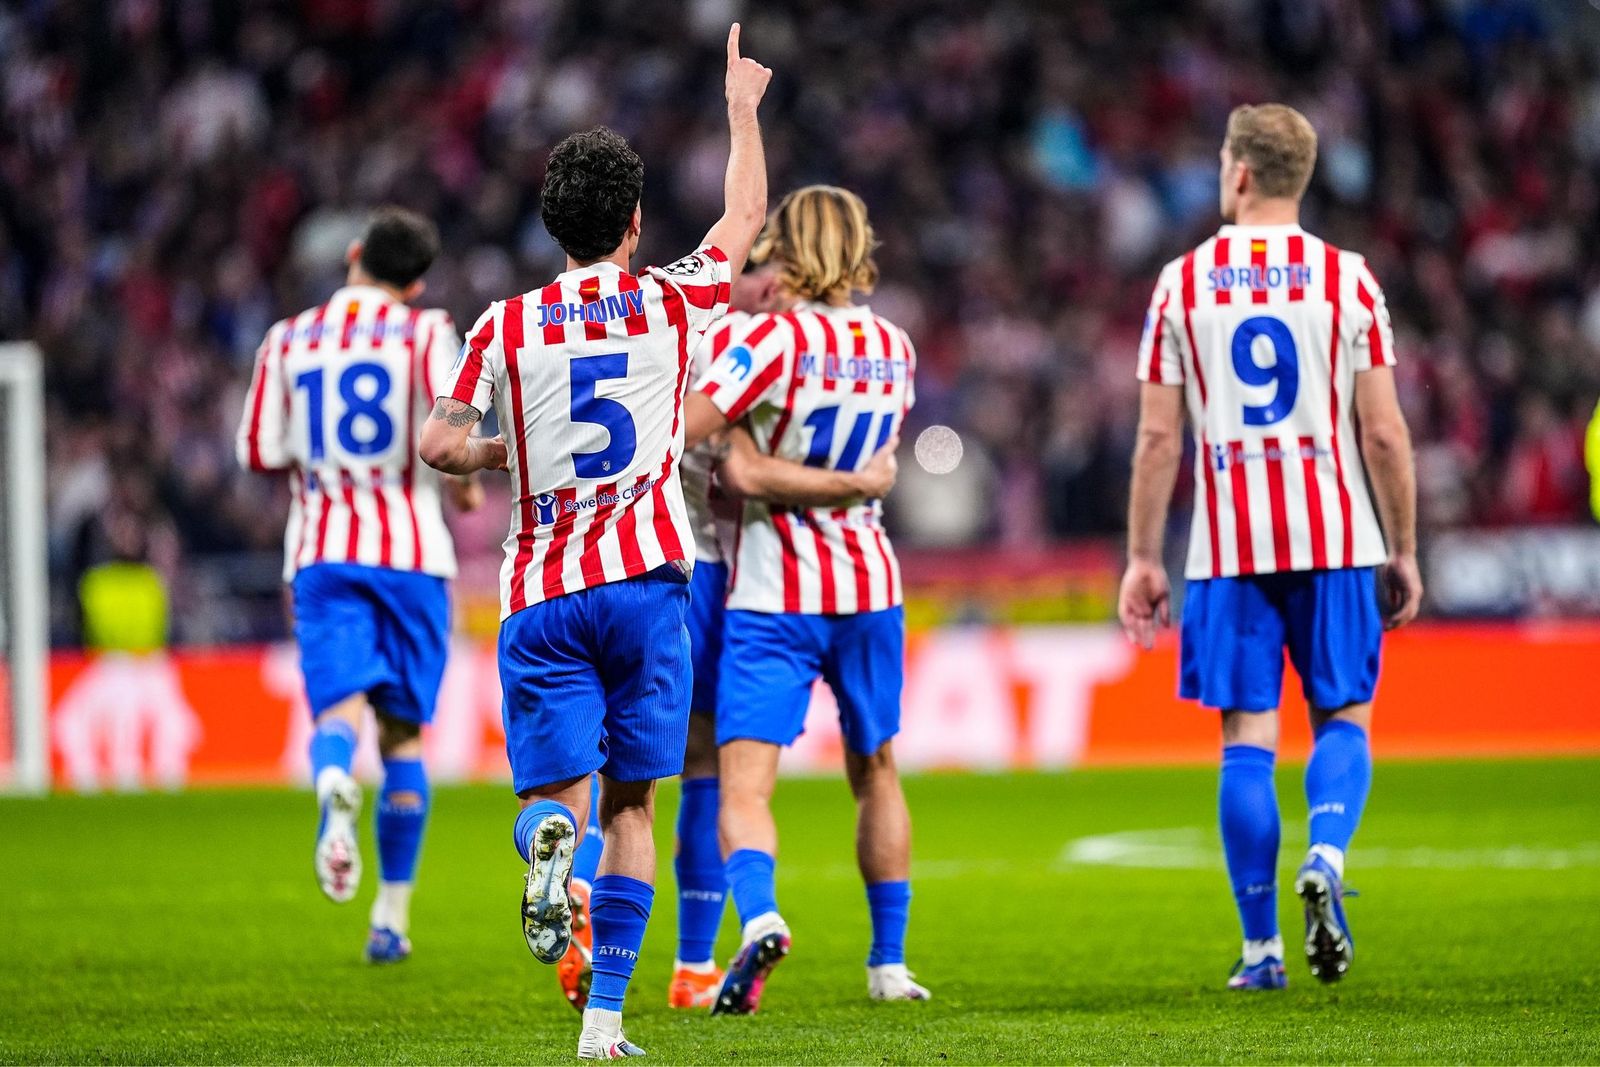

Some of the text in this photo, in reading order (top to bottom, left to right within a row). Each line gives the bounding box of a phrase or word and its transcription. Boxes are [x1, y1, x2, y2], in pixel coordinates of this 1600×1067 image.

[537, 289, 644, 328] JOHNNY
[1208, 266, 1311, 290] SØRLOTH
[1231, 316, 1299, 426] 9
[296, 362, 393, 460] 18
[570, 352, 637, 479] 5
[565, 500, 596, 512] Save
[599, 493, 620, 506] the
